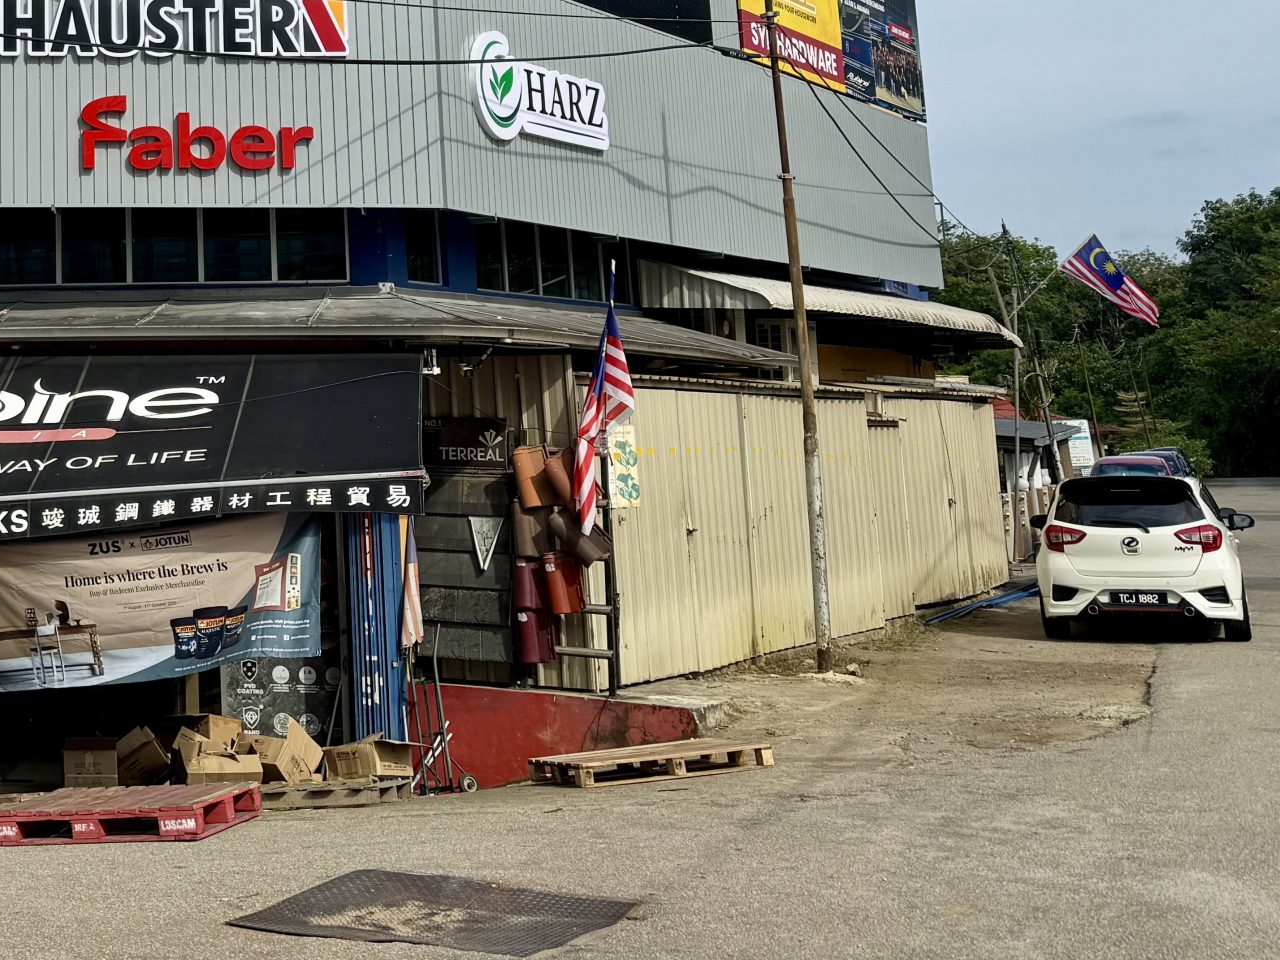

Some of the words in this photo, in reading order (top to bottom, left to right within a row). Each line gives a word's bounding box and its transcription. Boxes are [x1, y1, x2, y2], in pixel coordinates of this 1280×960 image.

[751, 22, 770, 50] SY
[776, 30, 838, 76] HARDWARE
[524, 68, 604, 128] HARZ
[81, 95, 314, 171] Faber
[66, 454, 122, 470] OF
[127, 448, 208, 466] LIFE
[439, 446, 505, 462] TERREAL
[88, 540, 122, 556] ZUS
[154, 535, 190, 548] JOTUN
[64, 574, 102, 589] Home
[104, 572, 115, 584] is
[115, 569, 156, 583] where
[157, 565, 178, 578] the
[180, 562, 215, 576] Brew
[216, 558, 228, 572] is
[89, 590, 101, 598] Buy
[109, 586, 135, 596] Redeem
[135, 583, 165, 594] Exclusive
[165, 578, 206, 590] Merchandise
[1119, 593, 1136, 603] TCJ
[1138, 593, 1159, 604] 1882
[206, 618, 225, 628] JOTUN
